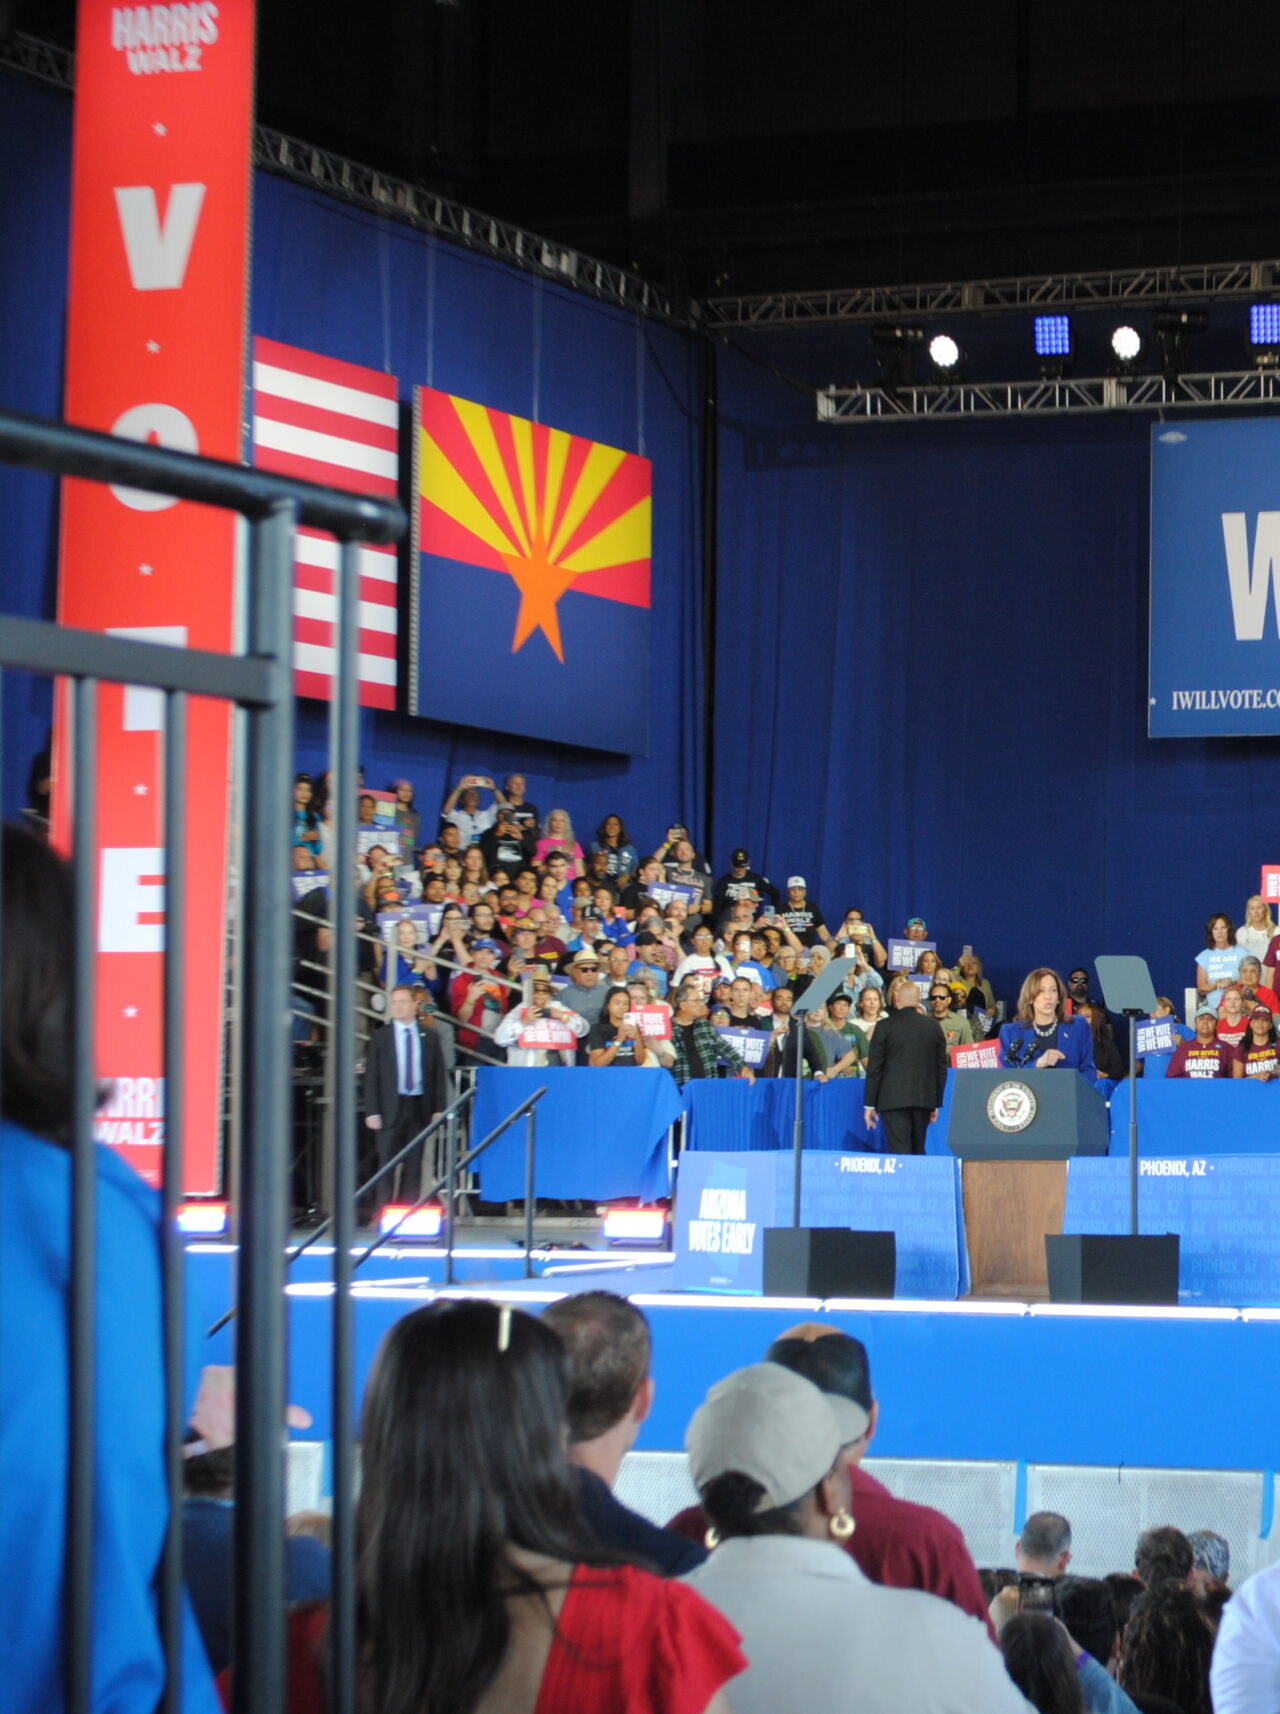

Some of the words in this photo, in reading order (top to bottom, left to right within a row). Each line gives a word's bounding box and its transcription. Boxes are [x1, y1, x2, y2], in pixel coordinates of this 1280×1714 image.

[111, 2, 219, 51] HARRIS
[126, 45, 203, 75] WALZ
[1145, 1025, 1156, 1038] WE
[1155, 1023, 1171, 1037] VOTE
[1146, 1038, 1158, 1051] WE
[1156, 1036, 1173, 1049] WIN
[966, 1050, 979, 1062] WE
[979, 1047, 996, 1059] VOTE
[1185, 1058, 1220, 1072] HARRIS
[1190, 1070, 1215, 1078] WALZ
[840, 1157, 883, 1174] PHOENIX,
[883, 1158, 896, 1173] AZ
[1140, 1160, 1190, 1177] PHOENIX,
[1192, 1160, 1206, 1176] AZ
[699, 1188, 747, 1221] ARIZONA
[689, 1220, 721, 1253] VOTES
[721, 1222, 757, 1254] EARLY
